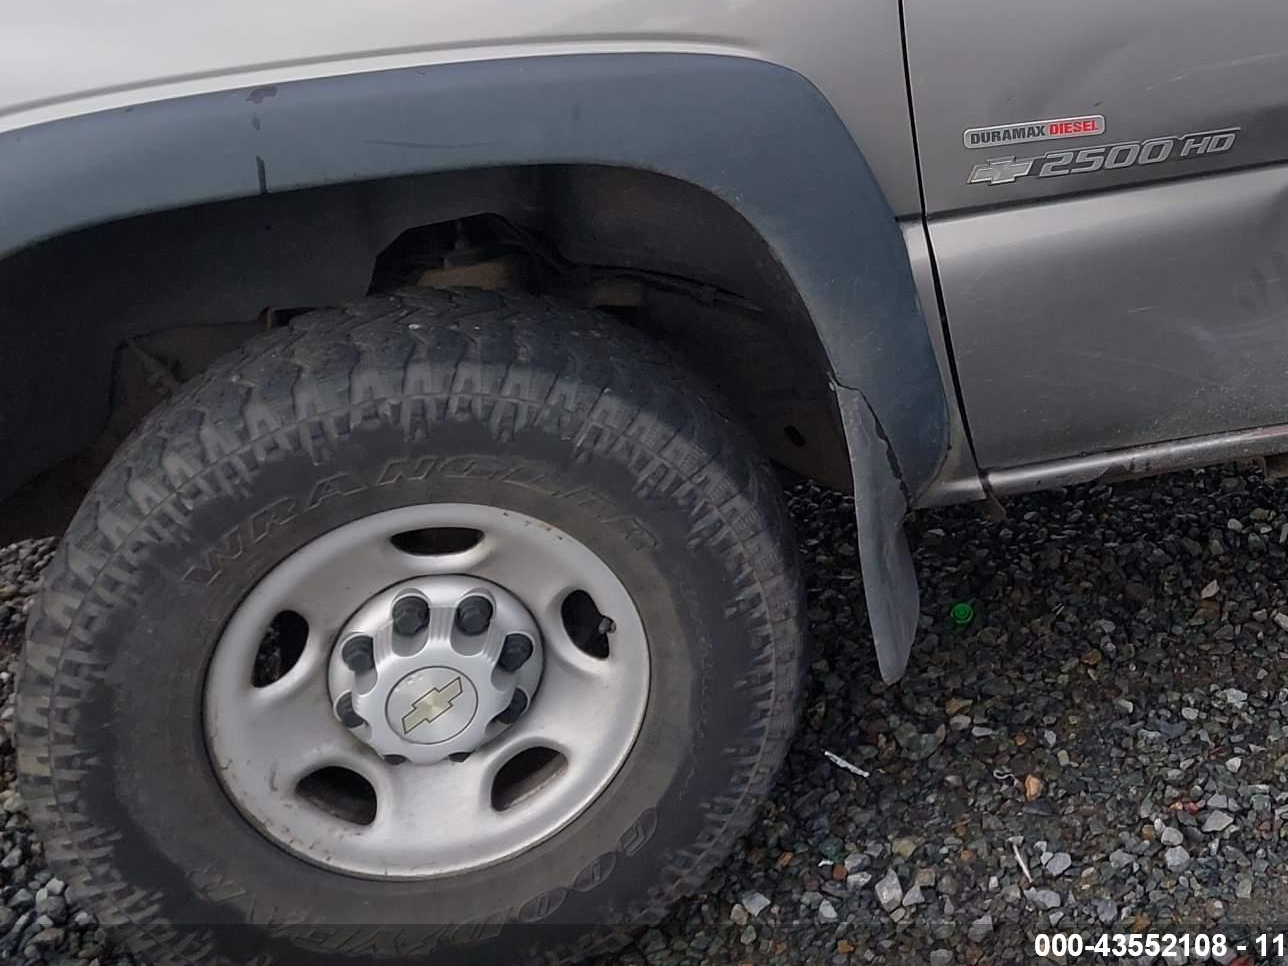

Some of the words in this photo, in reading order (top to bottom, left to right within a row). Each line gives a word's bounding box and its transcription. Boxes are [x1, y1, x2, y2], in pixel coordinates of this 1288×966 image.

[970, 124, 1046, 145] DURAMAX
[1048, 119, 1099, 136] DIESEL
[1038, 138, 1174, 178] 2500
[1179, 132, 1236, 158] HD
